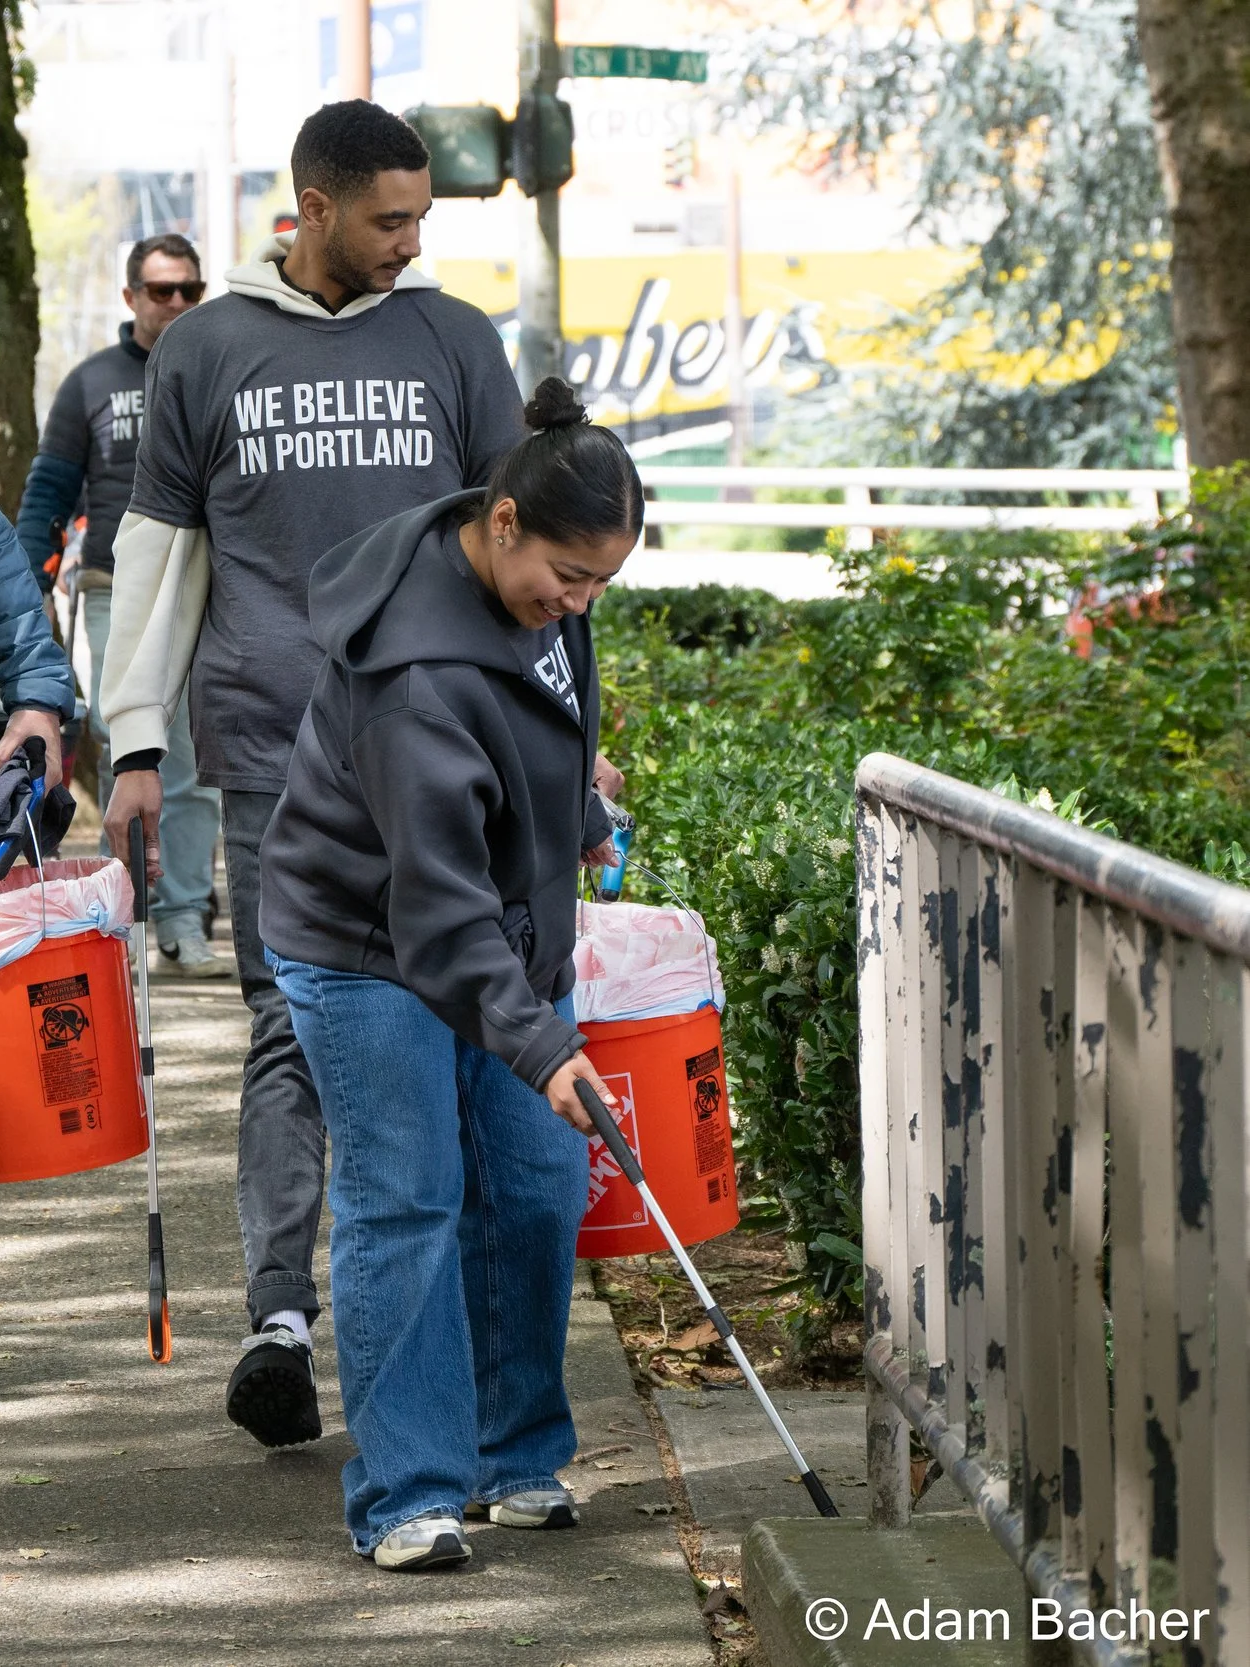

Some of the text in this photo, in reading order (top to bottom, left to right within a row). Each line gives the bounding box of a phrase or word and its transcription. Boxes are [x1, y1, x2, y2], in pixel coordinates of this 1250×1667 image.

[576, 48, 612, 75] SW
[110, 390, 144, 417] WE
[234, 380, 427, 432] WE BELIEVE
[112, 416, 132, 441] IN
[237, 428, 433, 476] IN PORTLAND
